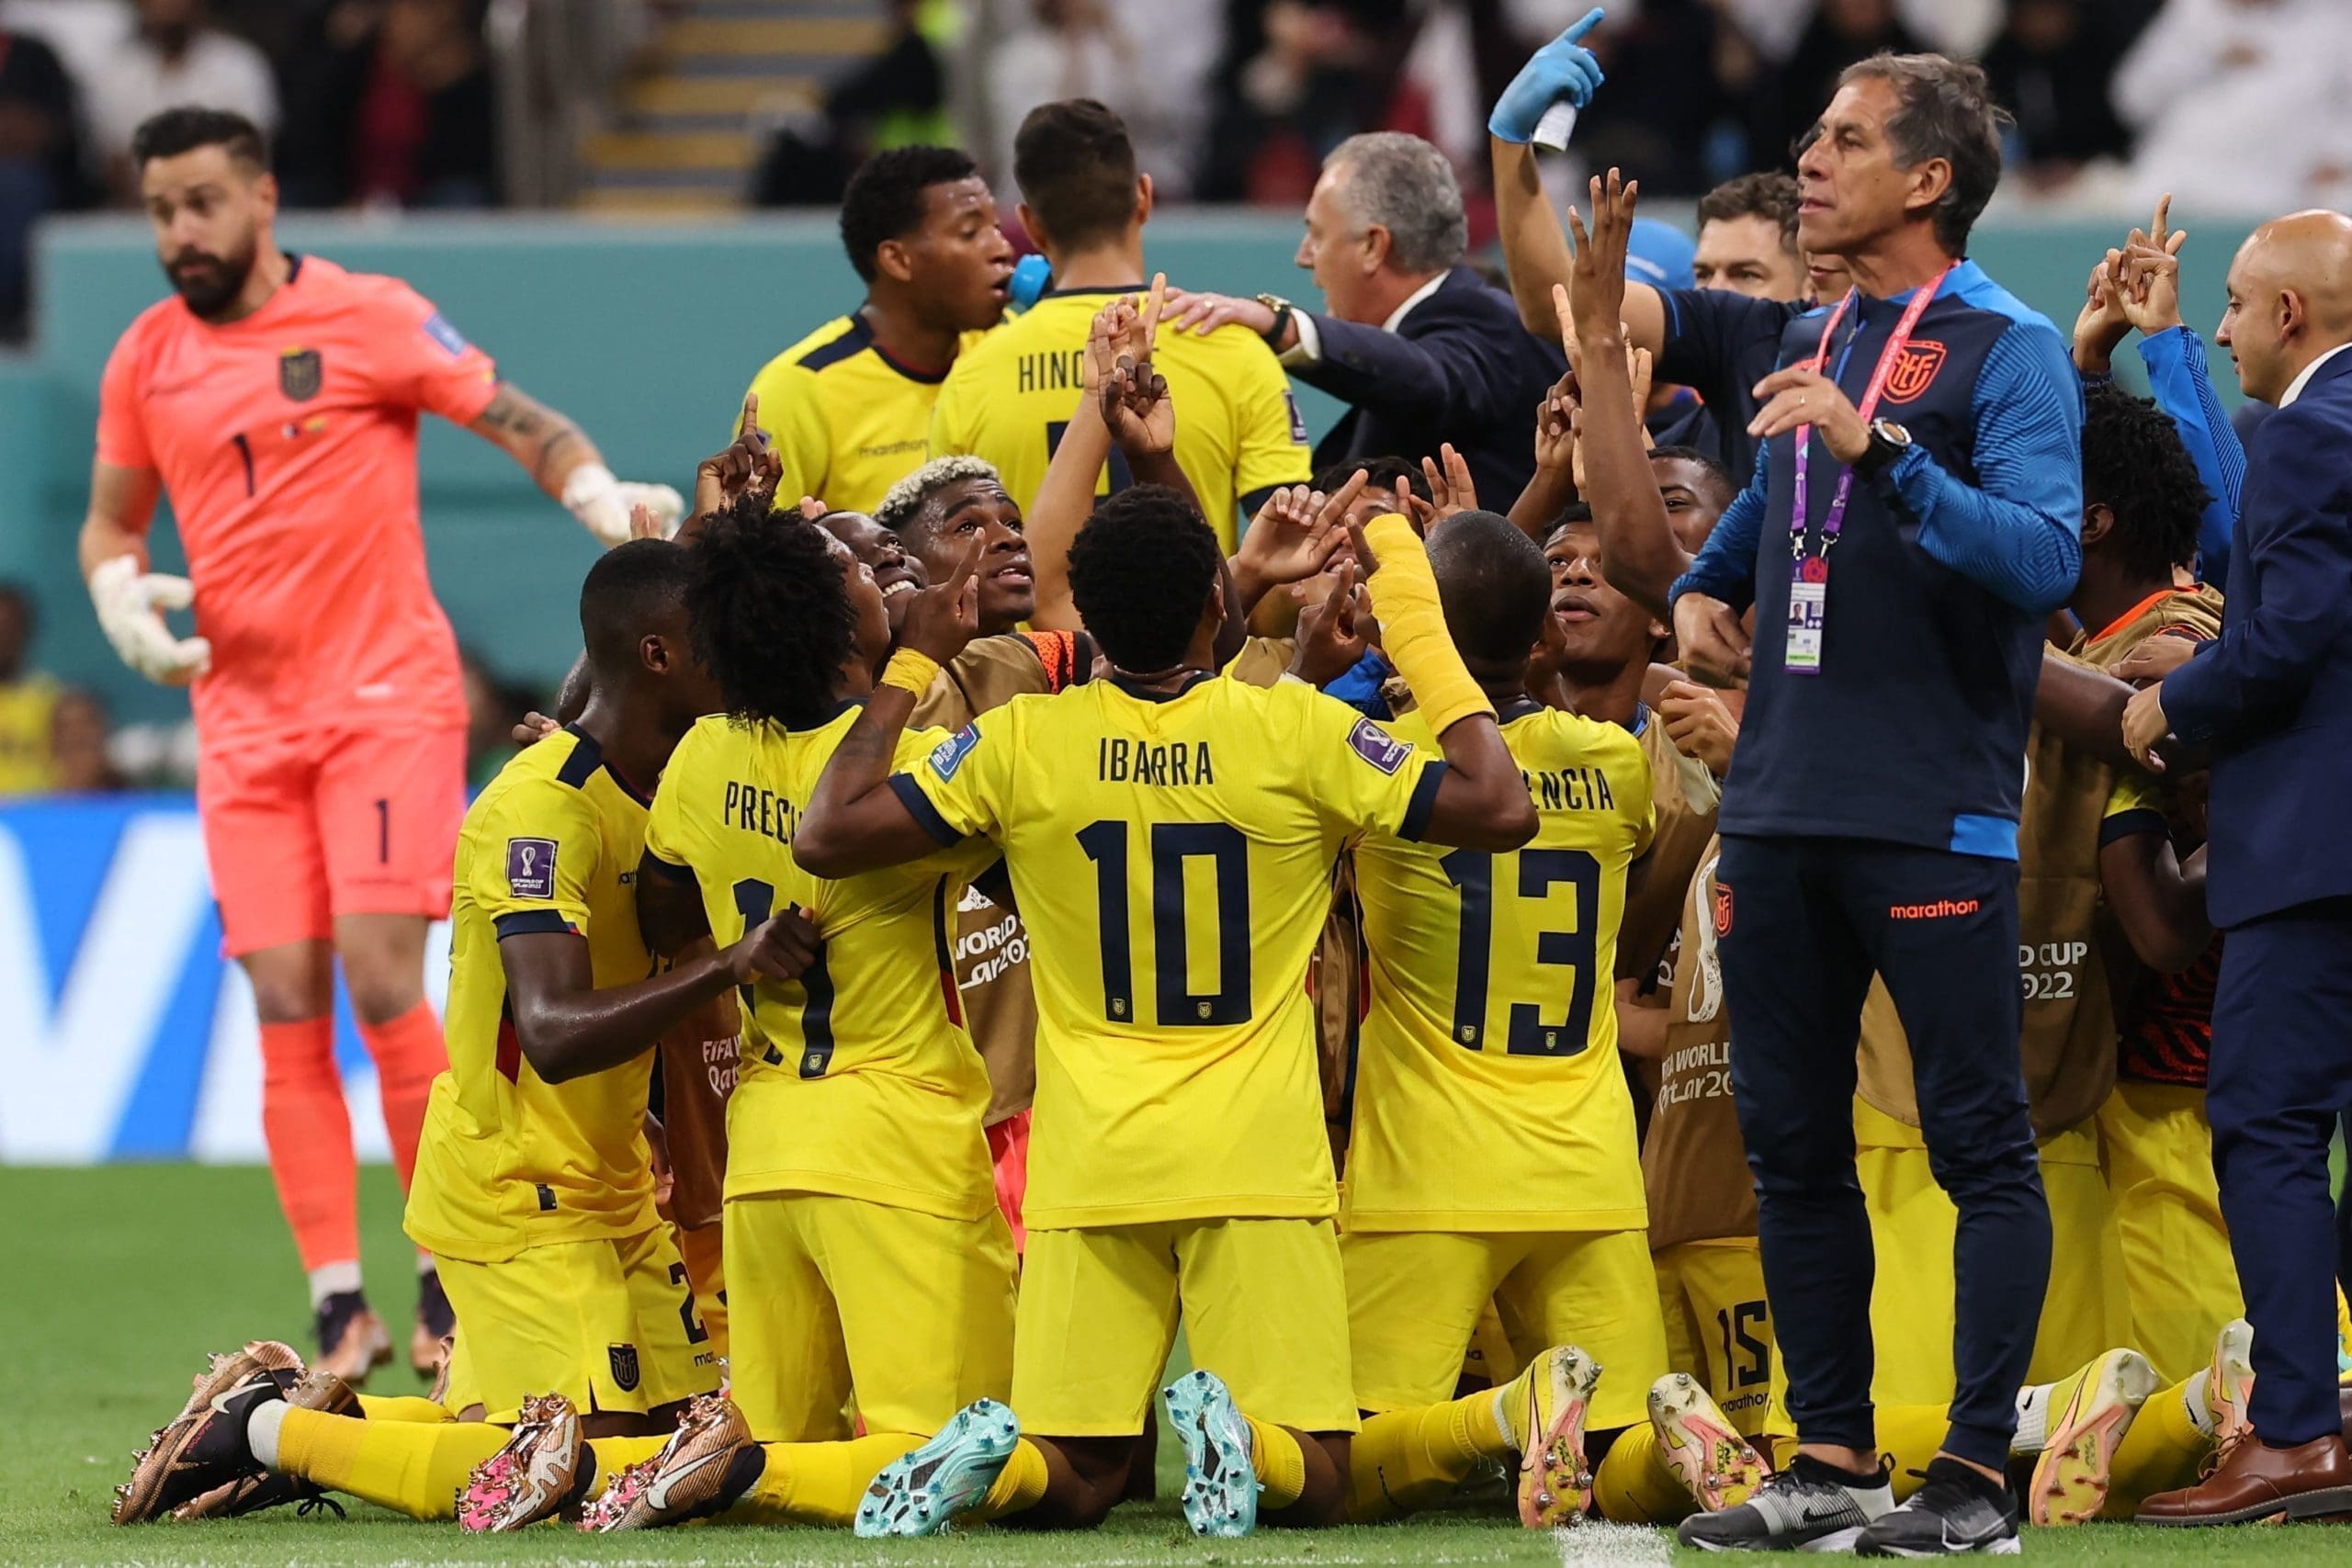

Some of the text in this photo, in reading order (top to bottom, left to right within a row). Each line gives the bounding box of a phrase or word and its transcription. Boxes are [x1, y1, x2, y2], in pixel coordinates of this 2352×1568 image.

[233, 433, 254, 498] 1
[1099, 736, 1215, 786] IBARRA
[375, 799, 390, 864] 1
[1076, 819, 1252, 1027] 10
[1891, 900, 1978, 919] marathon
[1440, 849, 1600, 1056] 13
[2039, 942, 2087, 966] CUP
[703, 1037, 734, 1064] FIFA
[1717, 1300, 1770, 1393] 15
